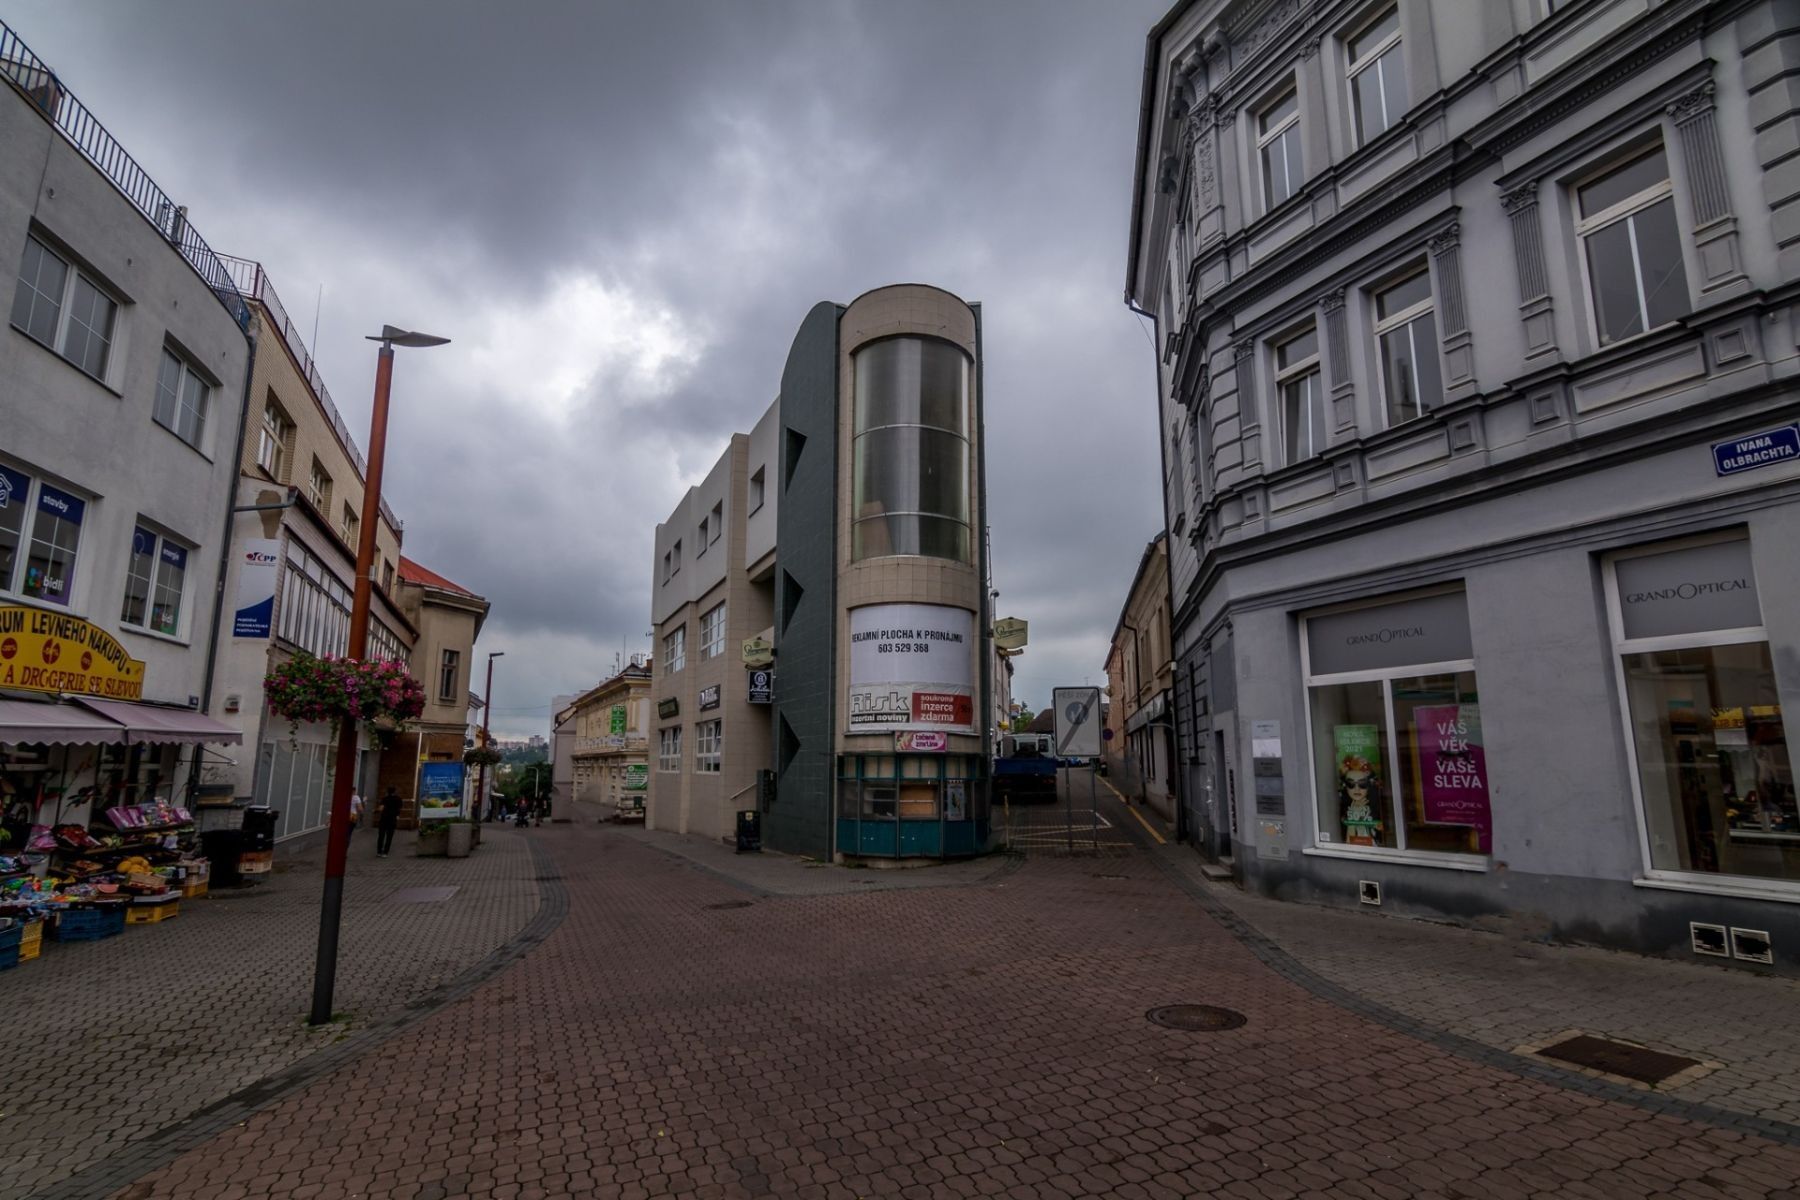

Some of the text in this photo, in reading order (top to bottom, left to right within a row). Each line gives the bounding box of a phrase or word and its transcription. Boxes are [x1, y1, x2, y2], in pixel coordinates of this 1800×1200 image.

[1736, 436, 1773, 454] IVANA
[1722, 444, 1795, 470] OLBRACHTA
[43, 495, 70, 513] stavby
[1626, 578, 1752, 604] GRANDOPTICAL
[880, 629, 914, 640] PLOCHA
[916, 630, 923, 639] K
[1346, 626, 1425, 646] GRANDOPTICAL
[878, 643, 929, 653] 603 529 368
[4, 664, 14, 684] A
[88, 675, 101, 694] SE
[104, 677, 142, 698] SLEVOU
[851, 691, 910, 713] Risk
[920, 702, 954, 711] inzerce
[876, 712, 908, 723] noviny
[920, 711, 955, 722] zdarma
[1437, 719, 1468, 736] VÁŠ
[1439, 736, 1469, 752] VĚK
[1436, 757, 1477, 774] VAŠE
[1434, 774, 1483, 789] SLEVA
